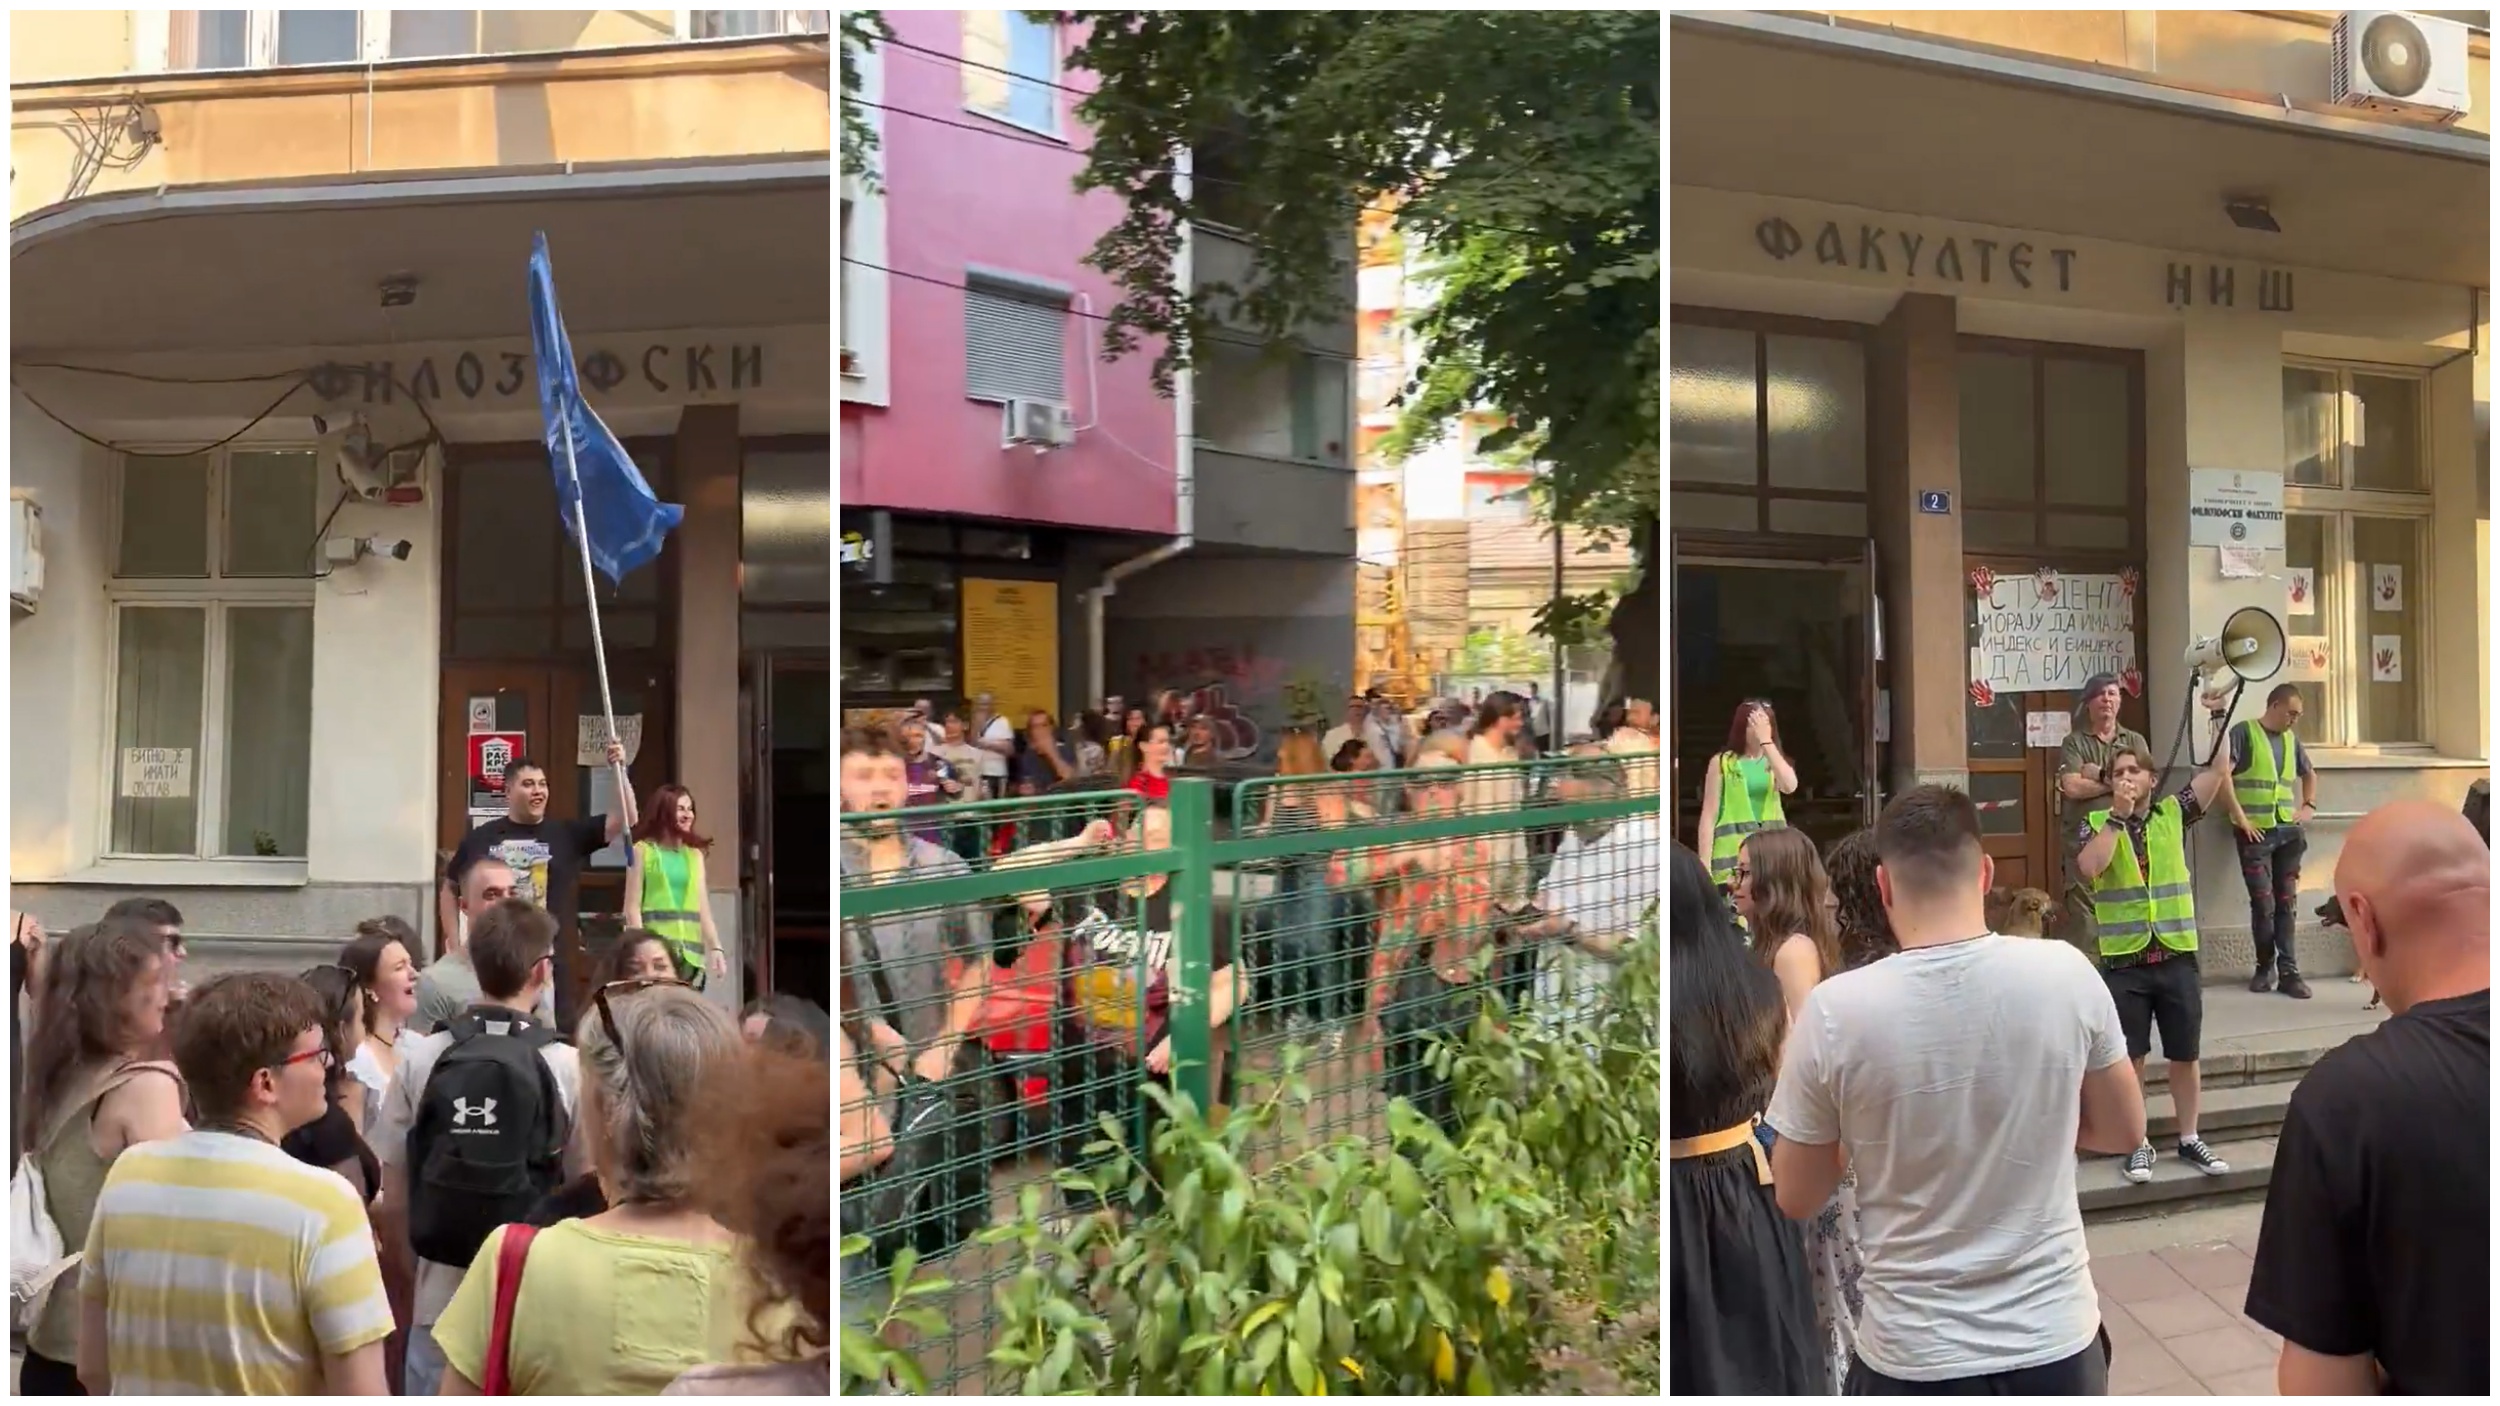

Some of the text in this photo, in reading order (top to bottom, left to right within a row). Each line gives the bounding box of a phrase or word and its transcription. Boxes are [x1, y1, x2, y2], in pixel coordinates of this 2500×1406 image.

[1755, 216, 2294, 312] ФАКУЛТЕТ НИШ
[309, 344, 763, 404] ФИЛОЗФСКИ
[1931, 494, 1939, 508] 2
[1982, 612, 2044, 634] МОРАЈУ
[2048, 613, 2076, 634] ДА
[1983, 635, 2042, 652] ИНДЕКС
[2050, 637, 2059, 651] И
[1989, 653, 2030, 685] ДА
[2043, 654, 2070, 682] БИ
[131, 748, 165, 764] БИТНО
[144, 765, 178, 780] ИМАТИ
